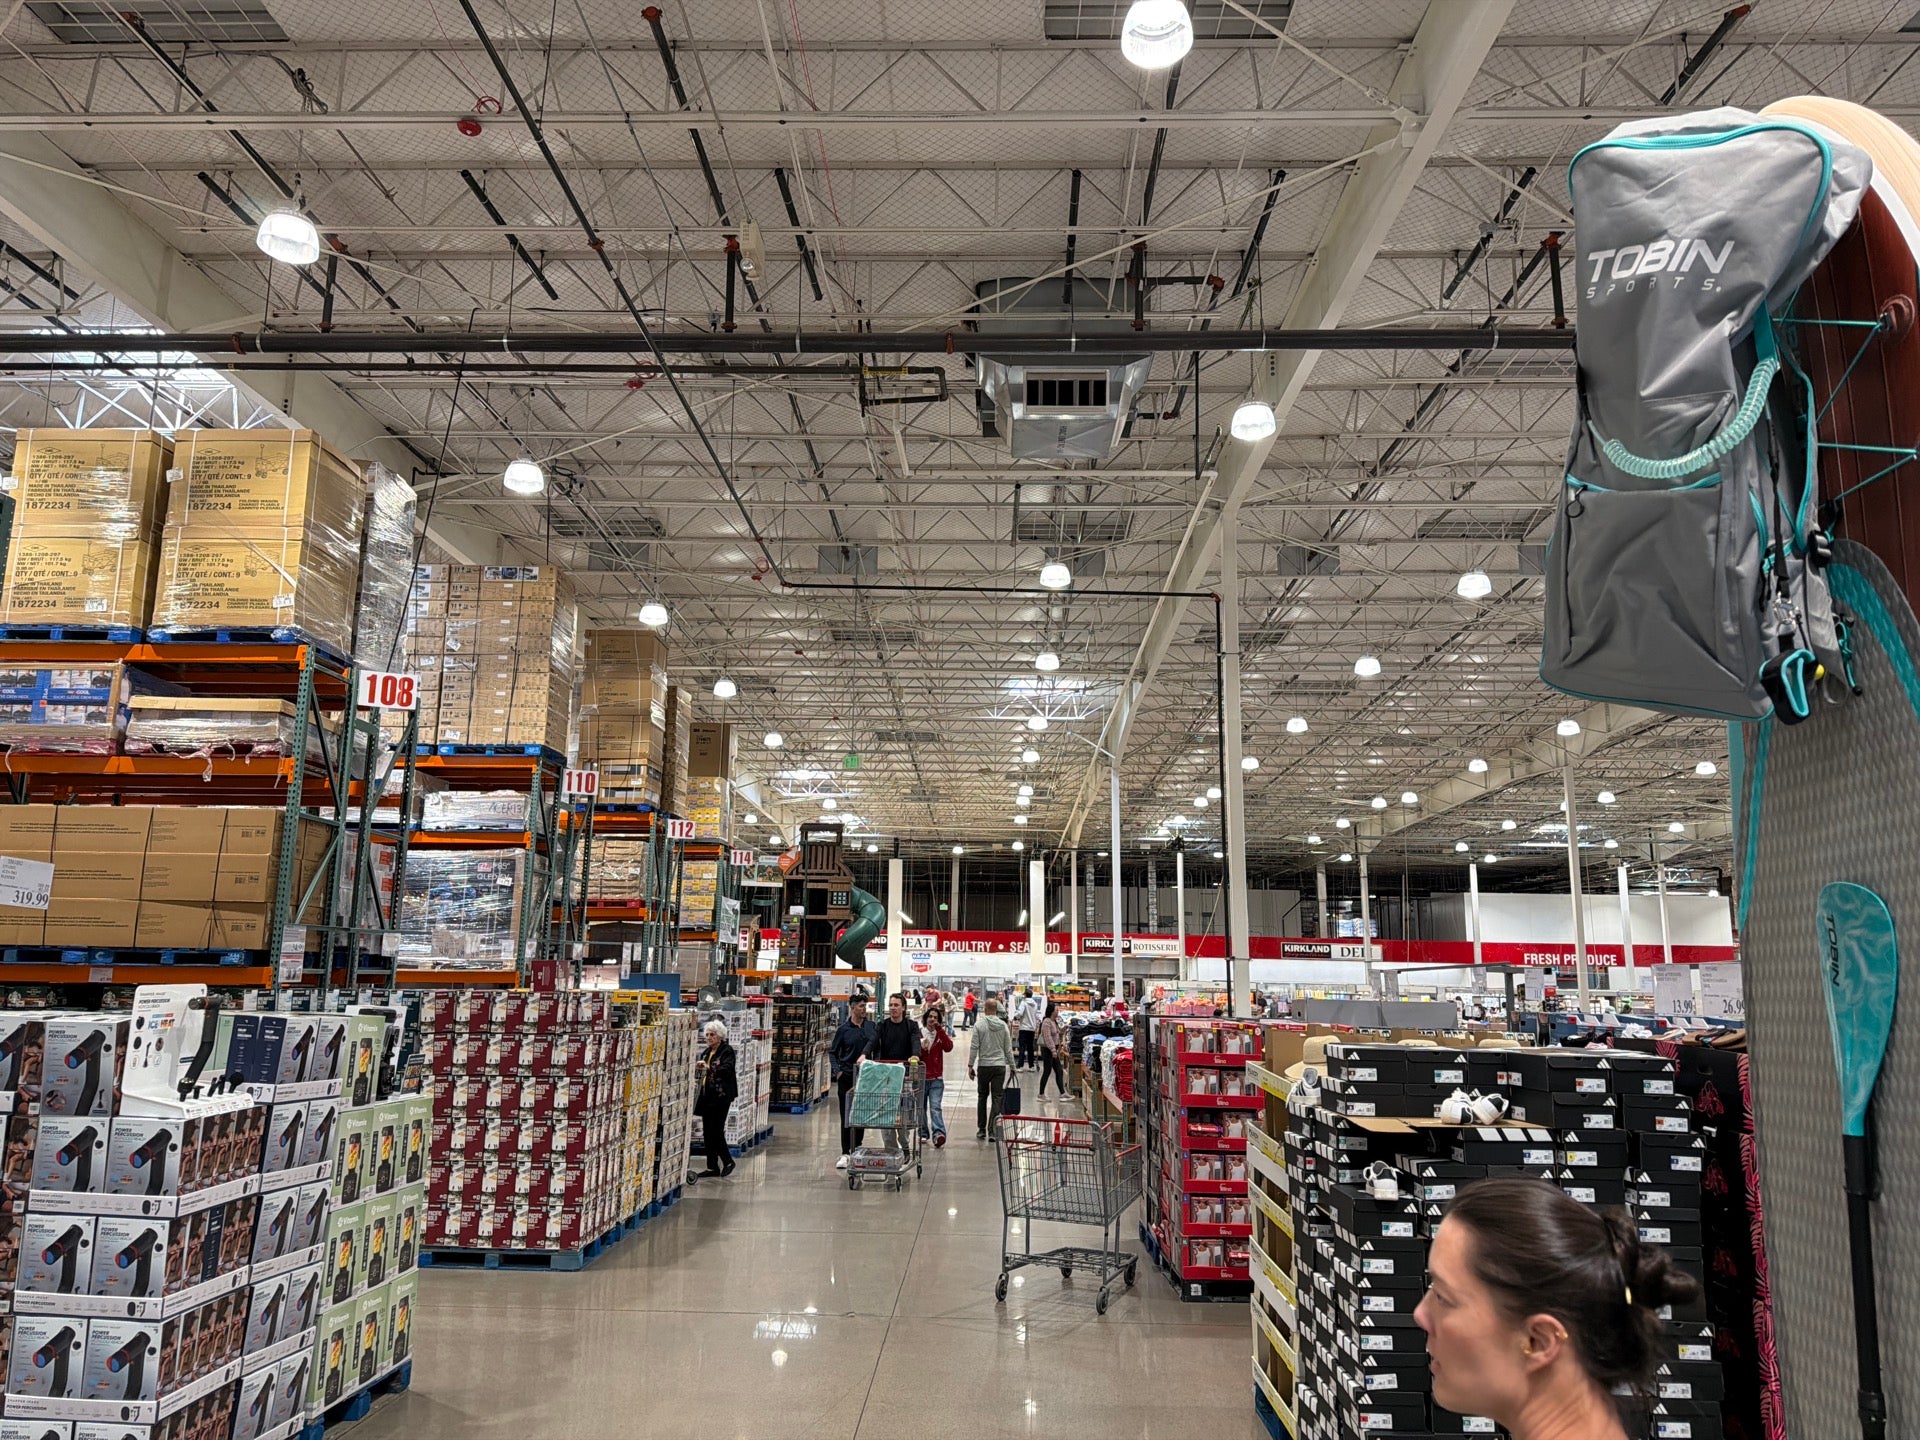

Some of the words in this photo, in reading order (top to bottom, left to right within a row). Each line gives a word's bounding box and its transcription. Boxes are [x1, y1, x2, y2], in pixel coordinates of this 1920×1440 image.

[1588, 239, 1735, 283] TOBIN
[12, 600, 57, 608] 1872234
[367, 674, 414, 707] 108
[566, 771, 596, 793] 110
[671, 822, 694, 838] 112
[733, 852, 751, 864] 114
[13, 890, 49, 906] 319.99
[761, 939, 780, 950] BEE
[943, 941, 992, 952] POULTRY
[1010, 942, 1060, 954] SEAOD
[1133, 943, 1179, 952] ROTISSERIE
[1284, 945, 1330, 953] KIRKLAND
[1826, 914, 1840, 987] TOBIN
[1524, 954, 1561, 965] FRESH
[1564, 954, 1618, 966] PRDUCE
[1673, 1000, 1693, 1014] 13.99
[148, 1021, 158, 1029] ICE
[160, 1019, 175, 1028] HEAT
[343, 1216, 359, 1224] Vitamix
